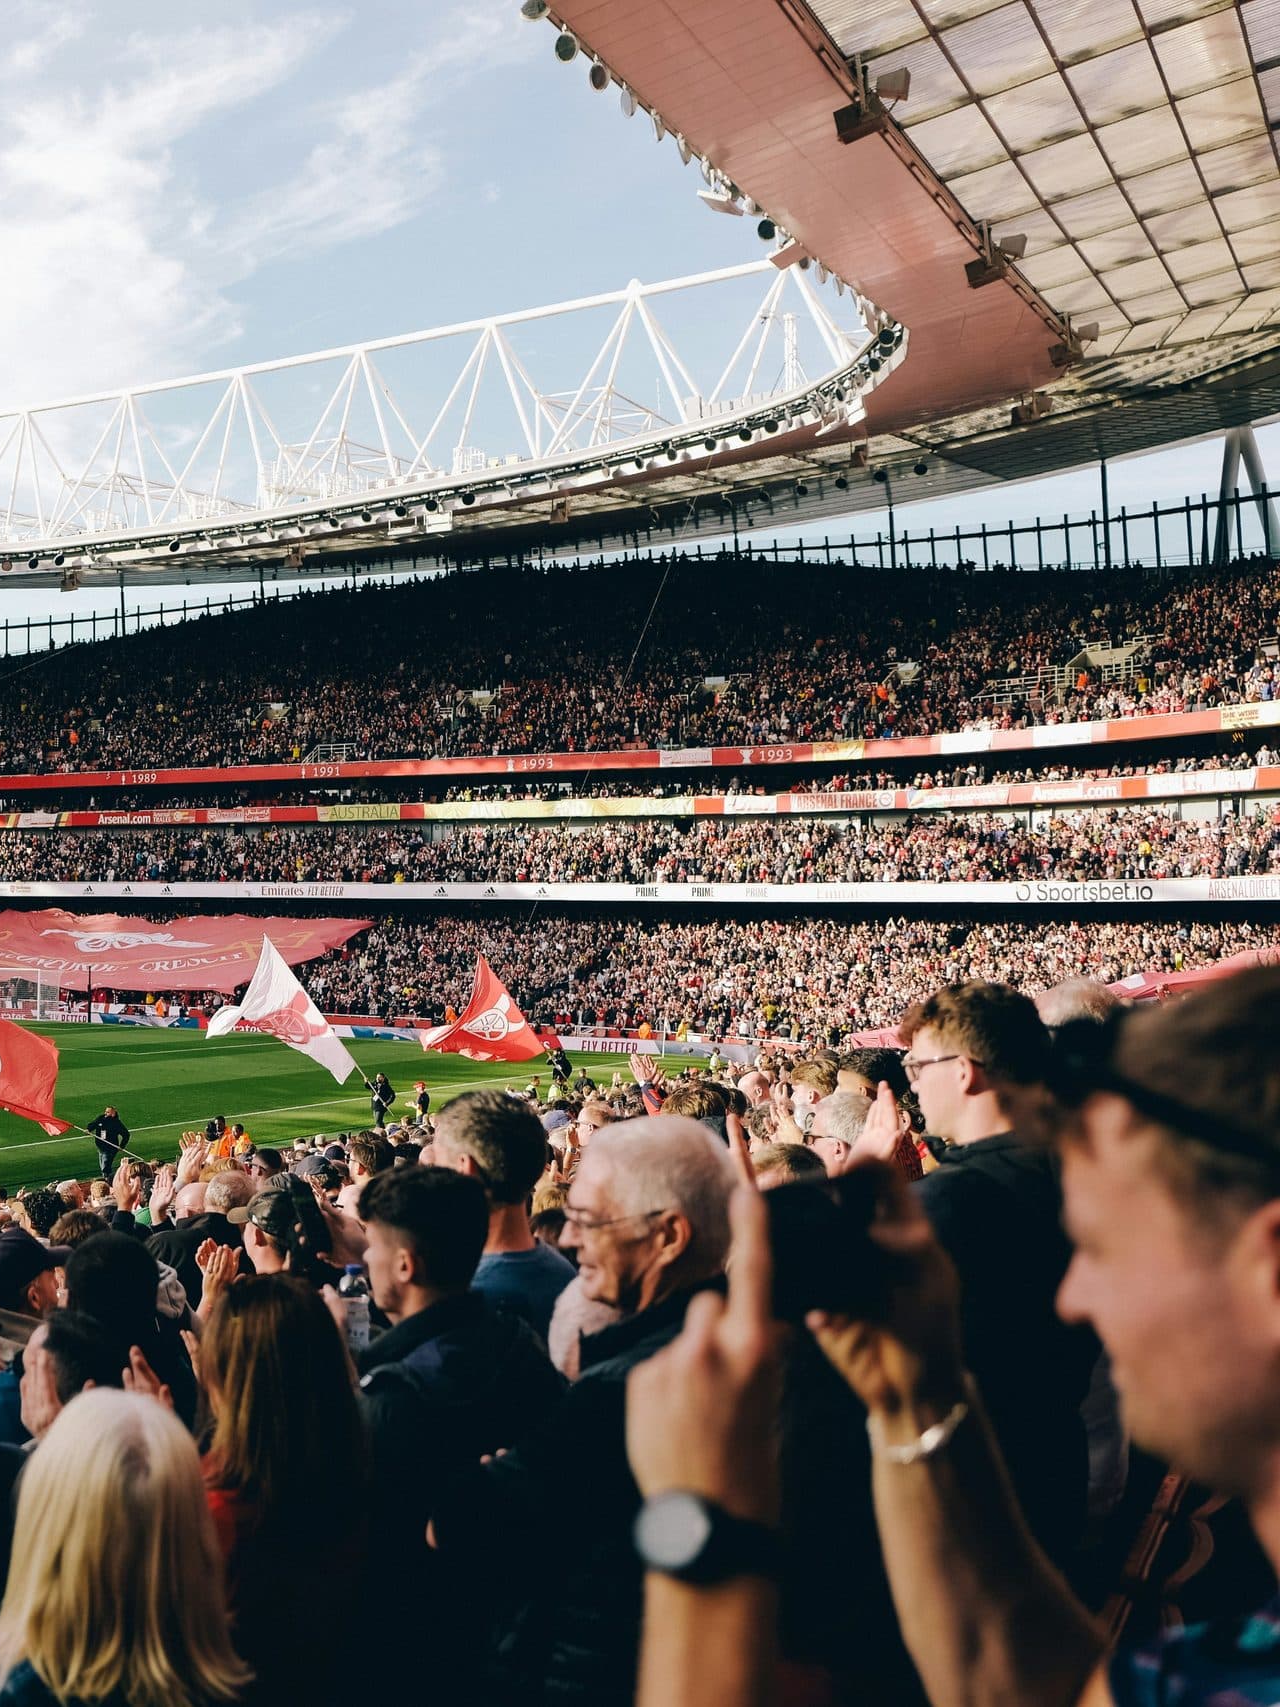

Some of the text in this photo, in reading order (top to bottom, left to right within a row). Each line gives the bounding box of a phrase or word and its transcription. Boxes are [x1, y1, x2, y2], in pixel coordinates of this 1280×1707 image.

[759, 749, 793, 762] 1993
[521, 758, 553, 769] 1993
[313, 767, 340, 777] 1991
[131, 773, 157, 784] 1989
[796, 792, 878, 809] ARSENAL FRANCE
[328, 806, 398, 820] AUSTRALIA
[98, 814, 151, 825] Arsenal.com
[261, 886, 304, 896] Emirates
[635, 887, 659, 897] PRIME
[691, 887, 714, 897] PRIME
[745, 887, 769, 897] PRIME
[1036, 882, 1154, 901] Sportsbet.io
